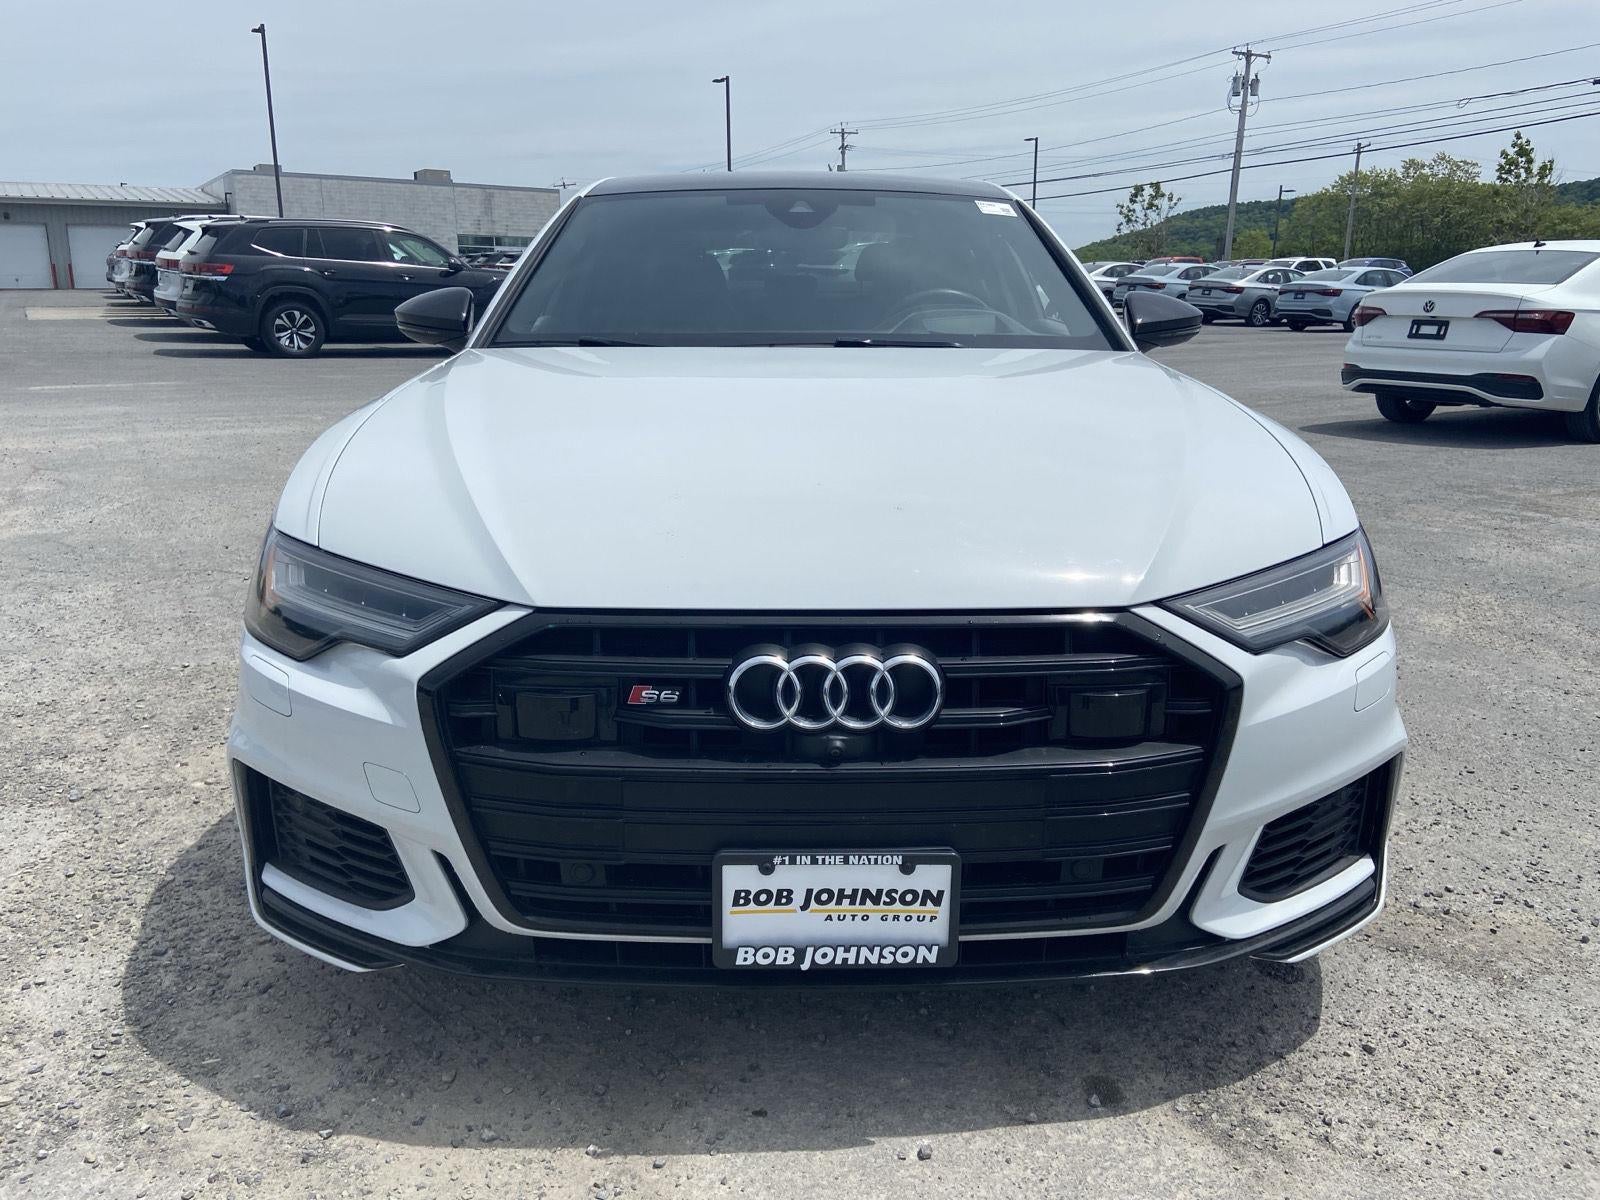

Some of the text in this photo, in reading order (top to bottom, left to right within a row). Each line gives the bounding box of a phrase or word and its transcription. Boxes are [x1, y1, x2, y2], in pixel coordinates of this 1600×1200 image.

[641, 690, 680, 703] S6
[772, 855, 903, 865] #1 IN THE NATION
[732, 888, 945, 911] BOB JOHNSON
[824, 914, 938, 923] AUTO GROUP
[735, 945, 939, 970] BOB JOHNSON
